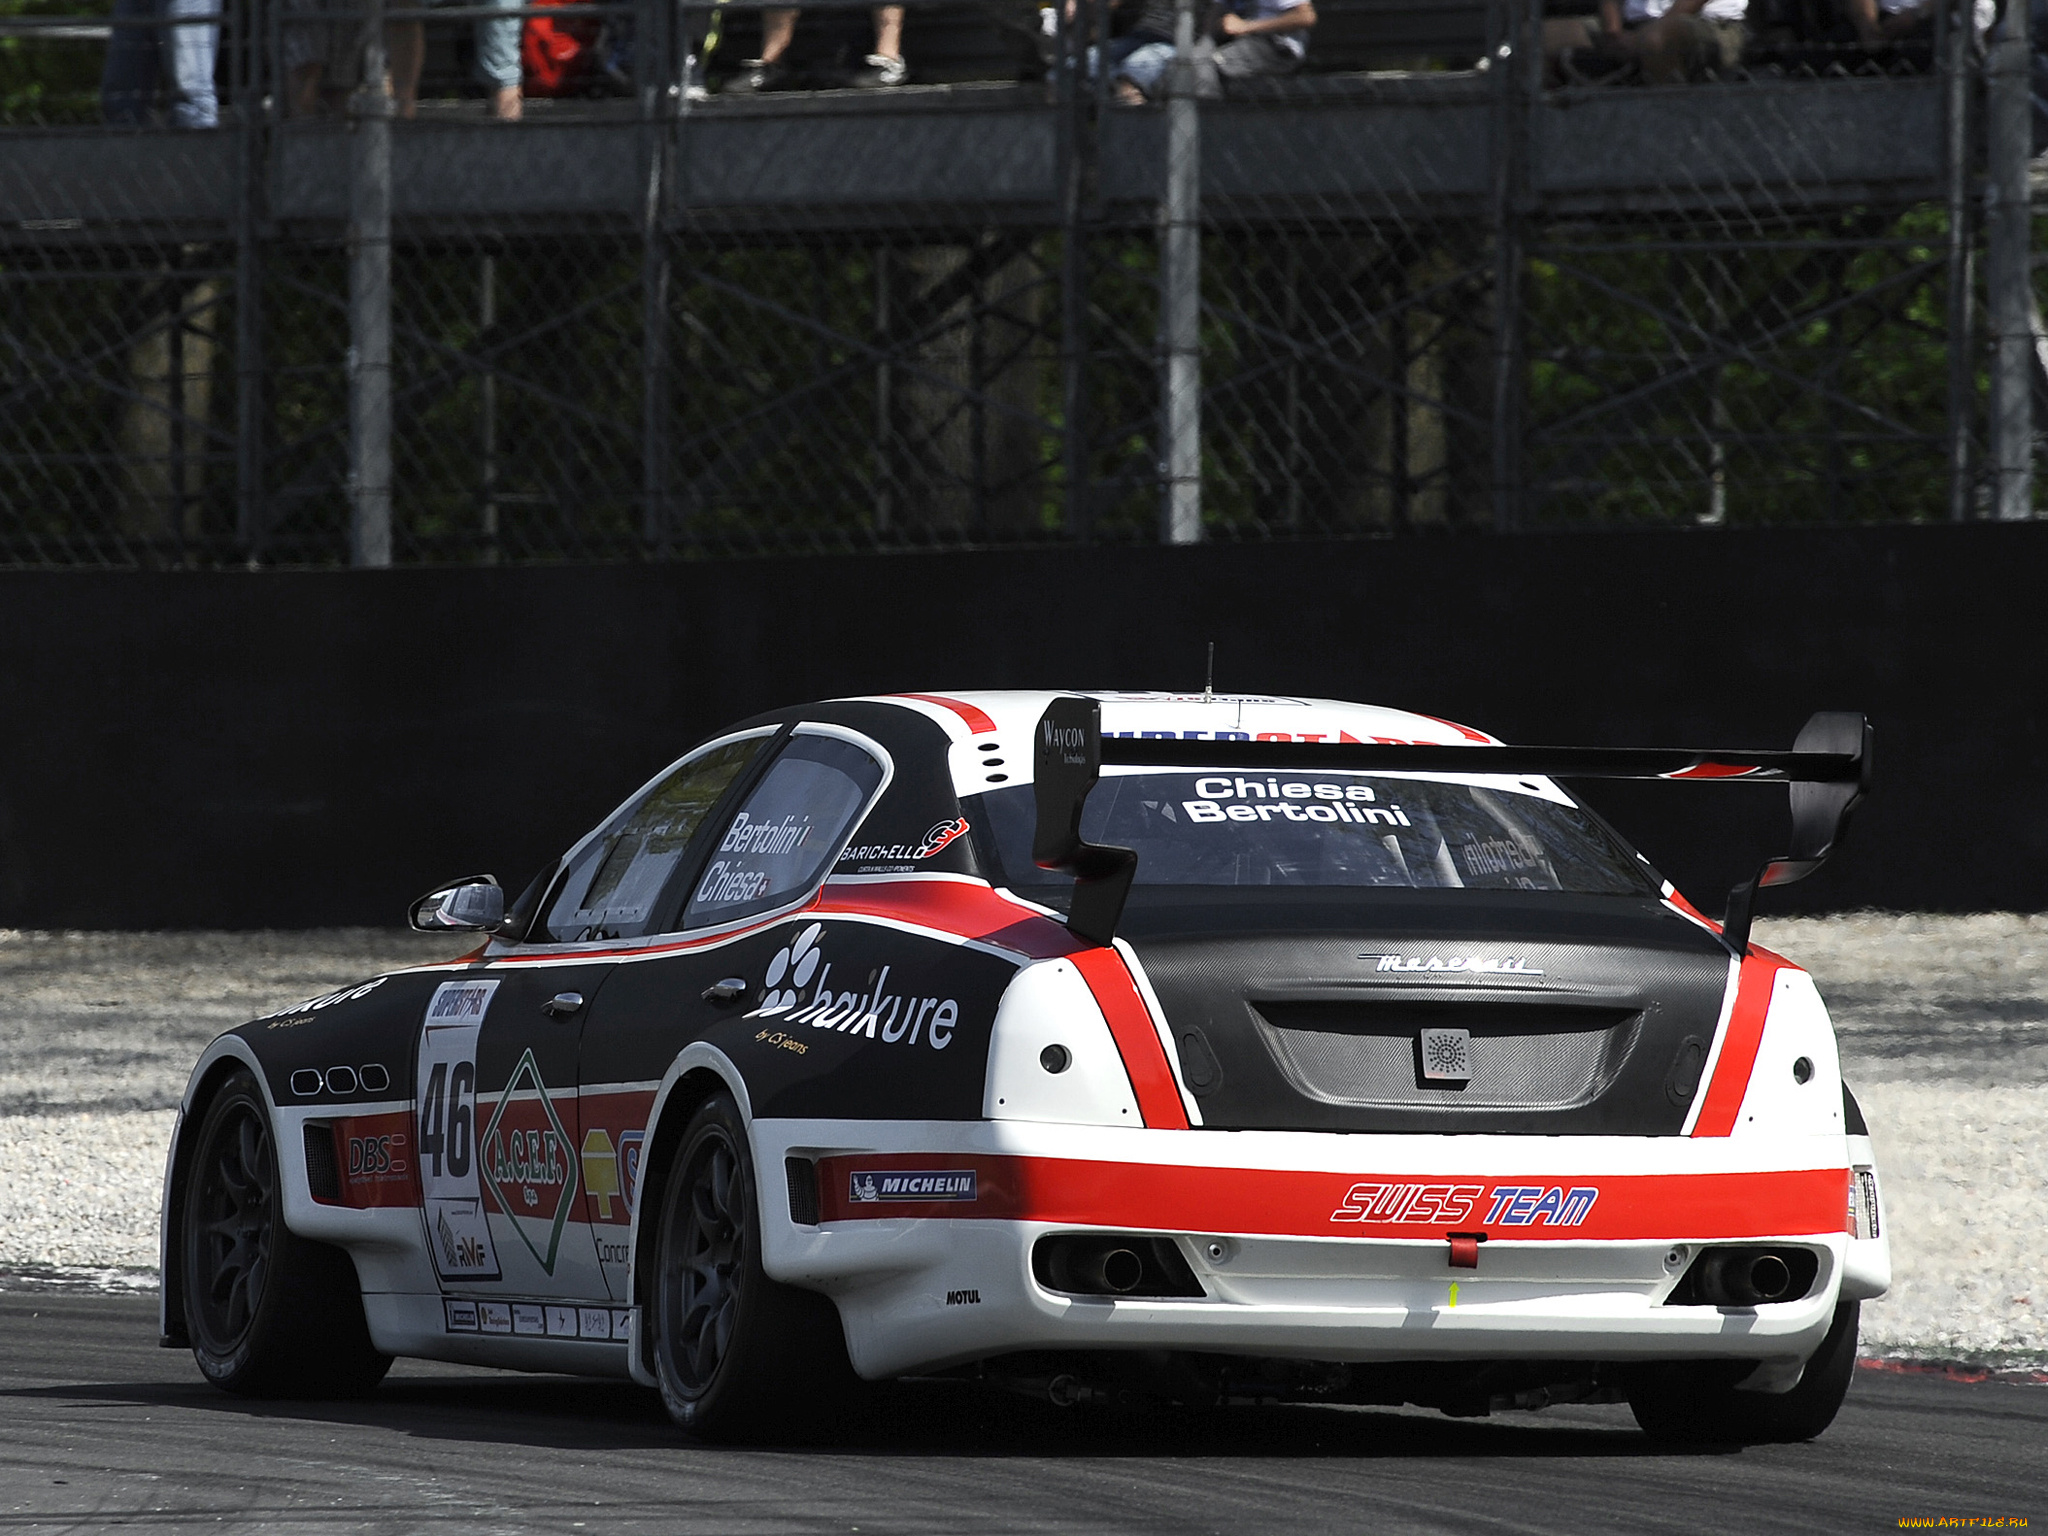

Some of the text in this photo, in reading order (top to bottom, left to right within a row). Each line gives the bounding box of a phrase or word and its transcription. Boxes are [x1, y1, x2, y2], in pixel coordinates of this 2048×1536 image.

[1195, 777, 1376, 802] Chiesa
[720, 812, 809, 855] Bertolini
[1182, 800, 1411, 826] Bertolini
[697, 861, 765, 902] Chiesa
[783, 963, 959, 1050] haikure
[755, 1029, 808, 1055] by CS jeans
[420, 1061, 475, 1178] 46
[494, 1128, 563, 1185] A.C.E.F.
[881, 1177, 971, 1193] MICHELIN
[1330, 1183, 1599, 1226] SWISS TEAM
[946, 1289, 981, 1306] MOTUL
